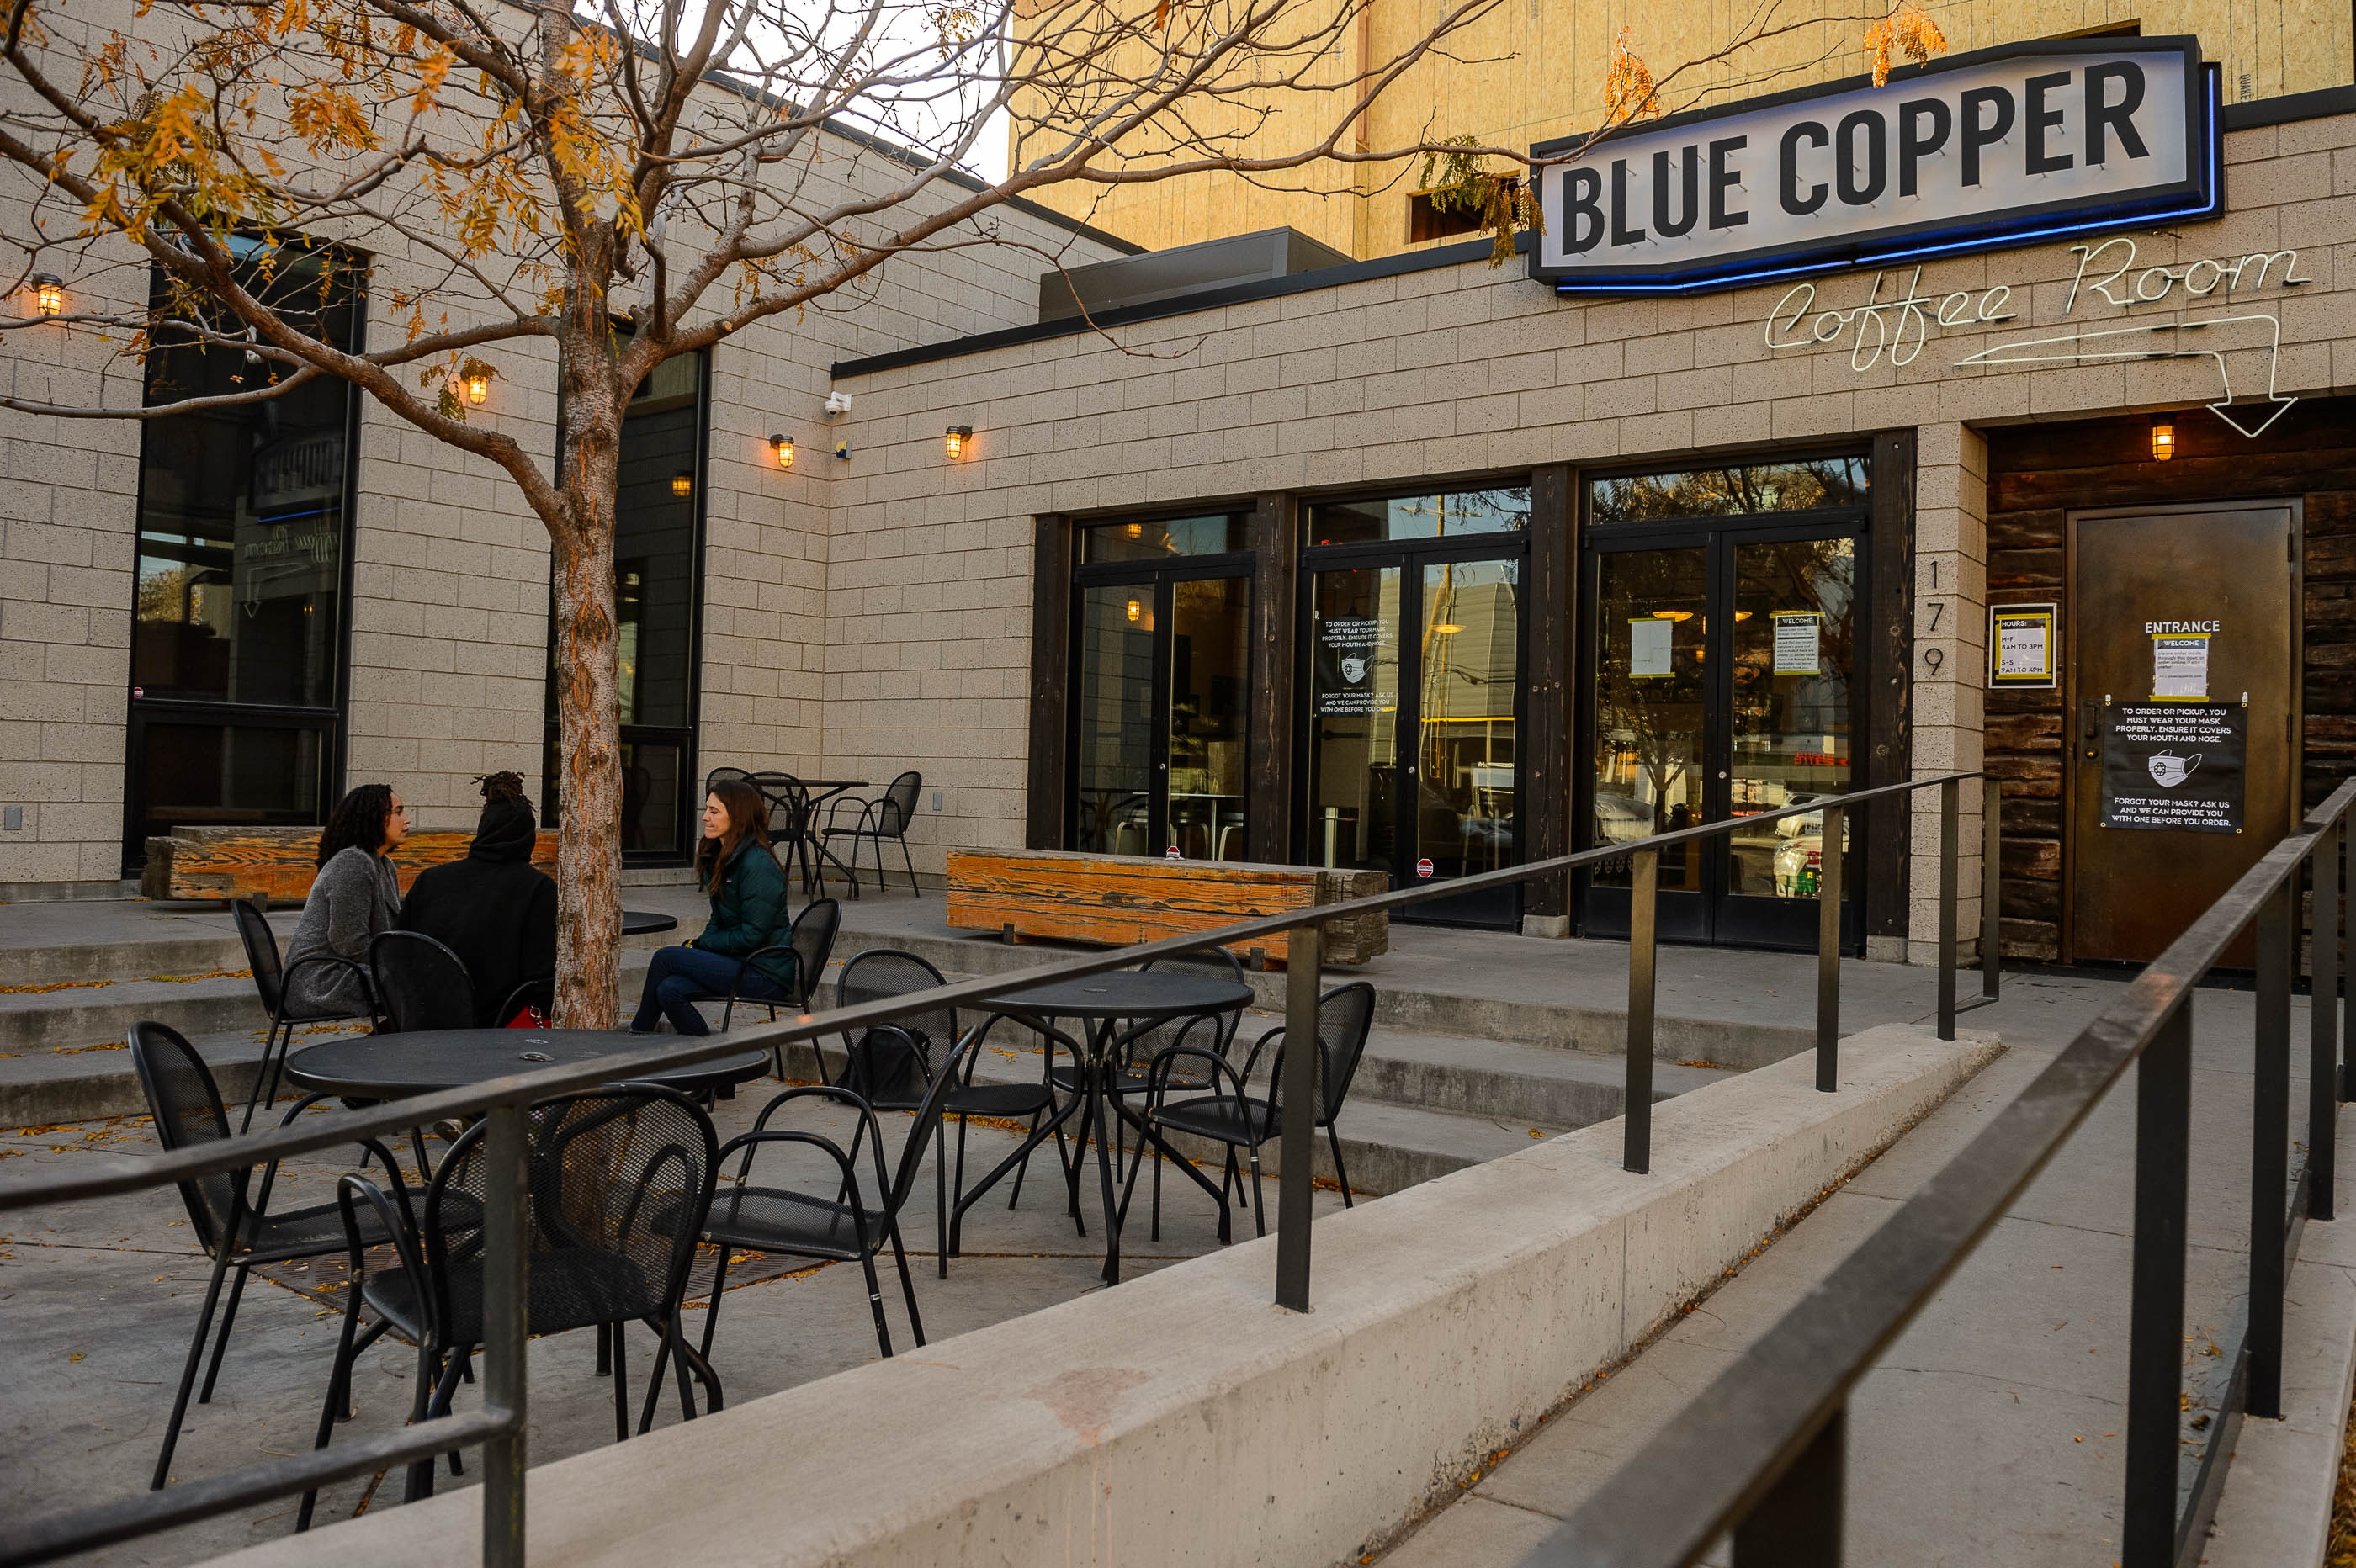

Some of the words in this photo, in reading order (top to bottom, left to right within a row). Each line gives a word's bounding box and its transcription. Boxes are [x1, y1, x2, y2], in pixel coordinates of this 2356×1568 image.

[1561, 135, 1749, 256] BLUE
[1779, 60, 2150, 217] COPPER
[1765, 265, 2017, 372] Coffee
[2066, 238, 2313, 314] Room
[2145, 620, 2221, 633] ENTRANCE
[2171, 808, 2204, 817] PROVIDE
[2202, 818, 2231, 827] ORDER.
